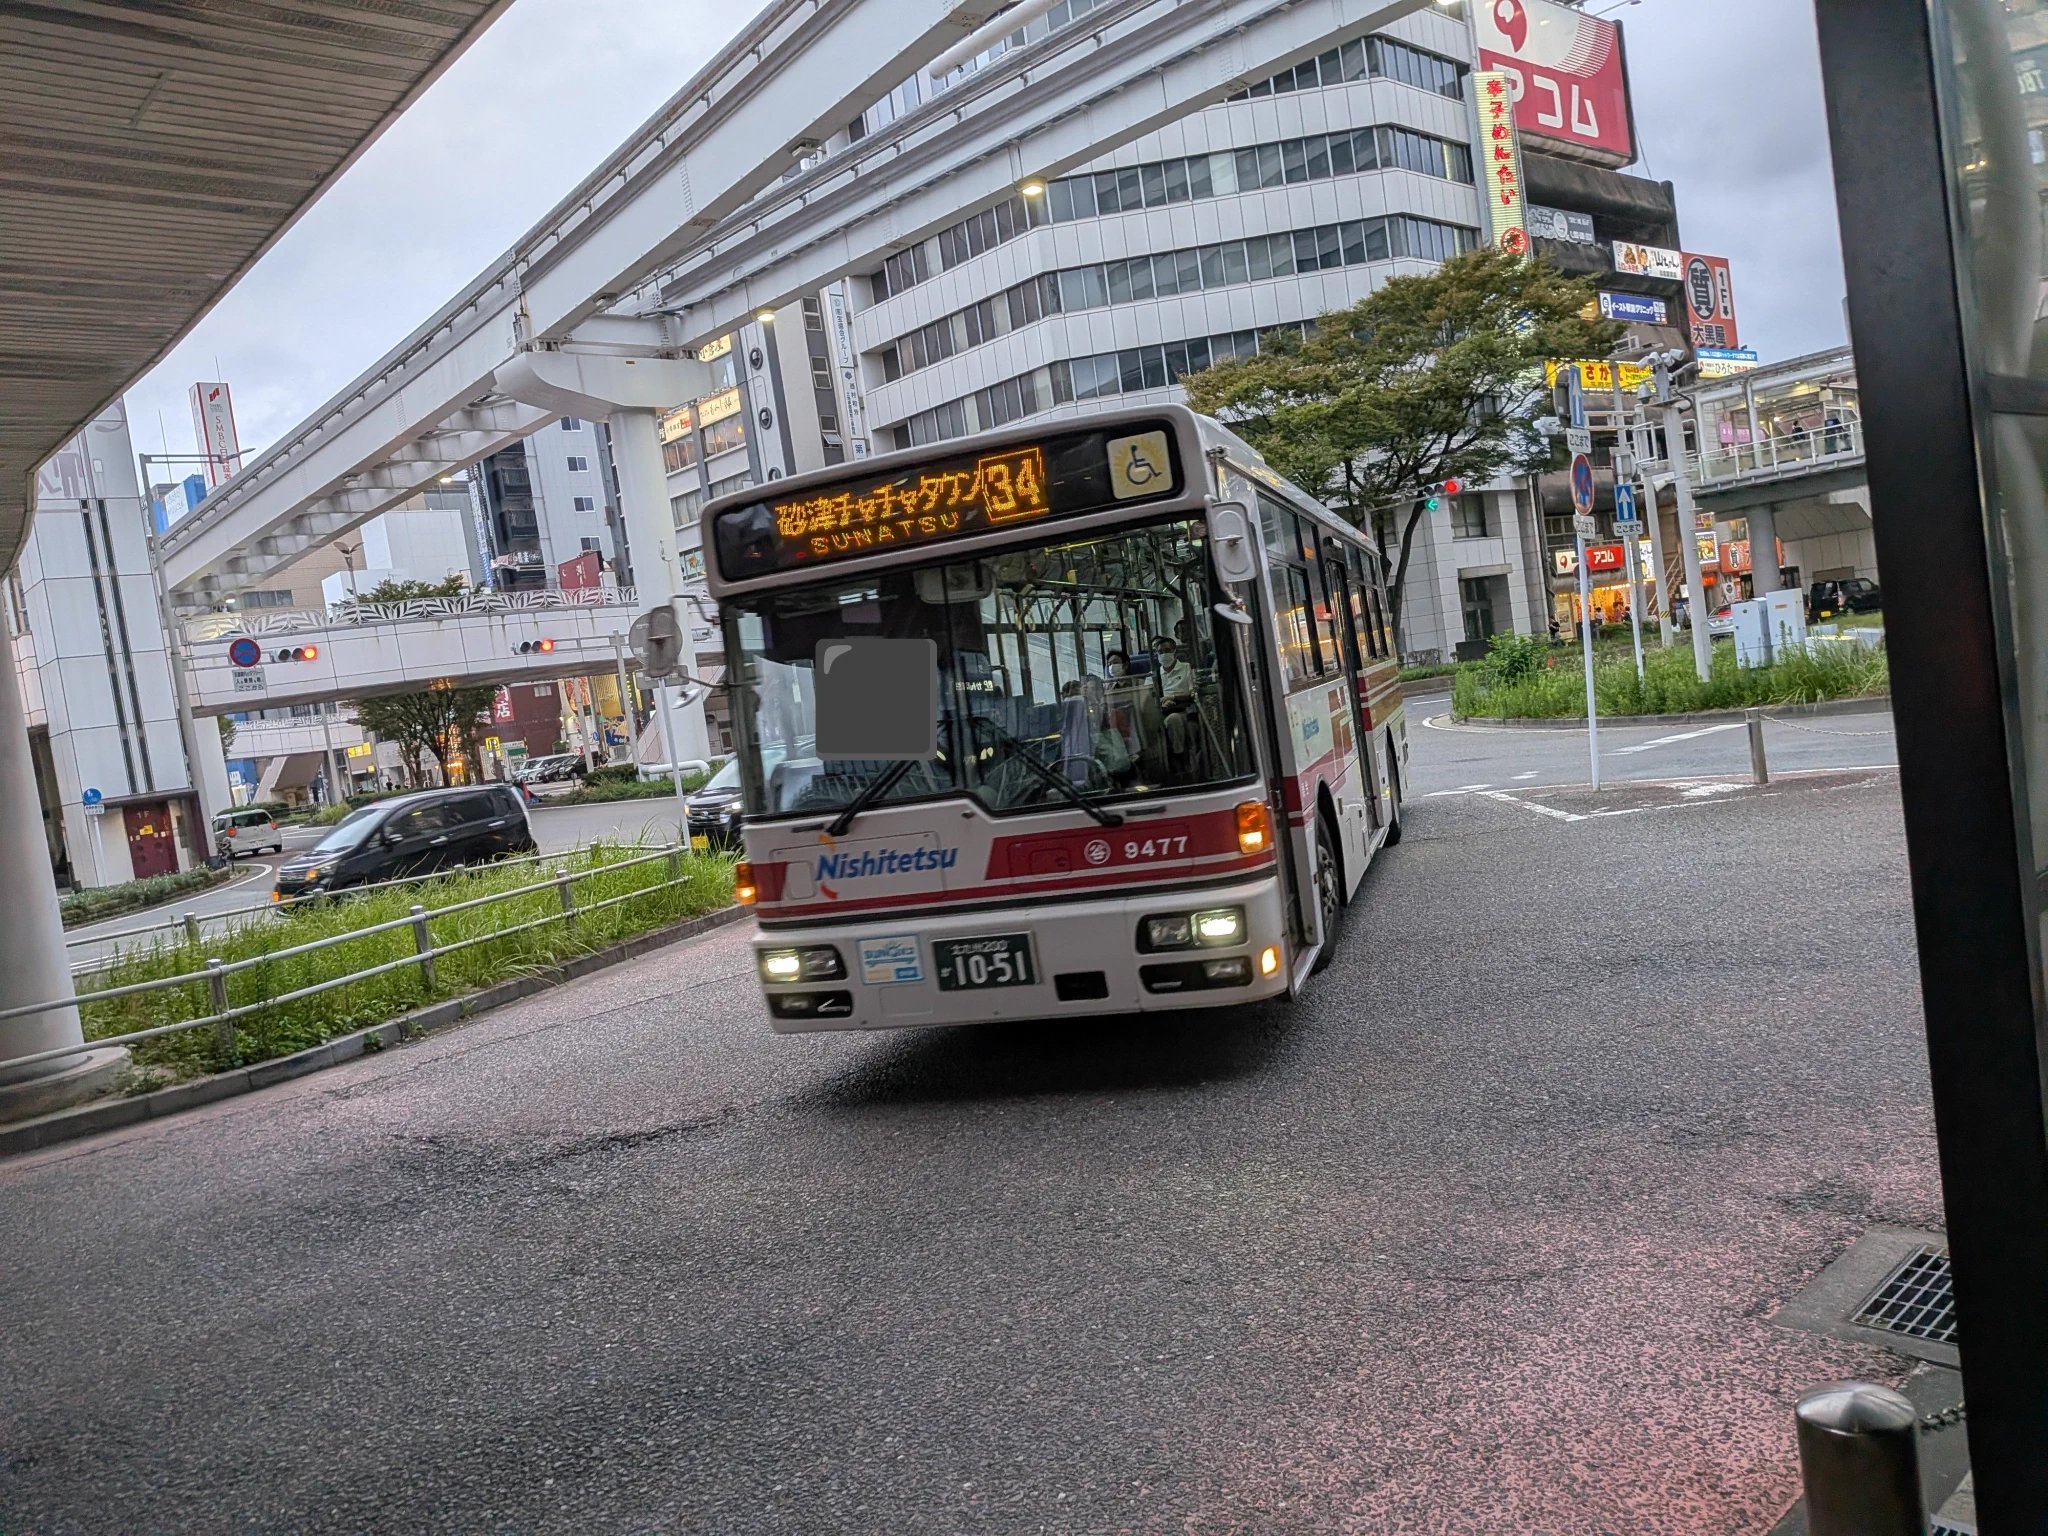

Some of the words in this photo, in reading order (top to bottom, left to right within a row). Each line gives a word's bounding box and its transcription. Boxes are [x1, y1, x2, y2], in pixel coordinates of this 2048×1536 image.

[1492, 62, 1599, 138] アコム
[1690, 267, 1714, 317] 質
[1719, 271, 1728, 303] 1F
[1693, 325, 1726, 345] 大黒屋
[215, 416, 232, 480] SMBC日証券
[1569, 433, 1589, 448] ここまで
[986, 459, 1041, 512] 34
[811, 511, 959, 555] SUNATSU
[1616, 525, 1641, 534] ここまで
[1593, 550, 1615, 564] アコム
[815, 846, 958, 881] Nishitetsu
[1124, 836, 1189, 859] 9477
[955, 951, 1027, 986] 10-51
